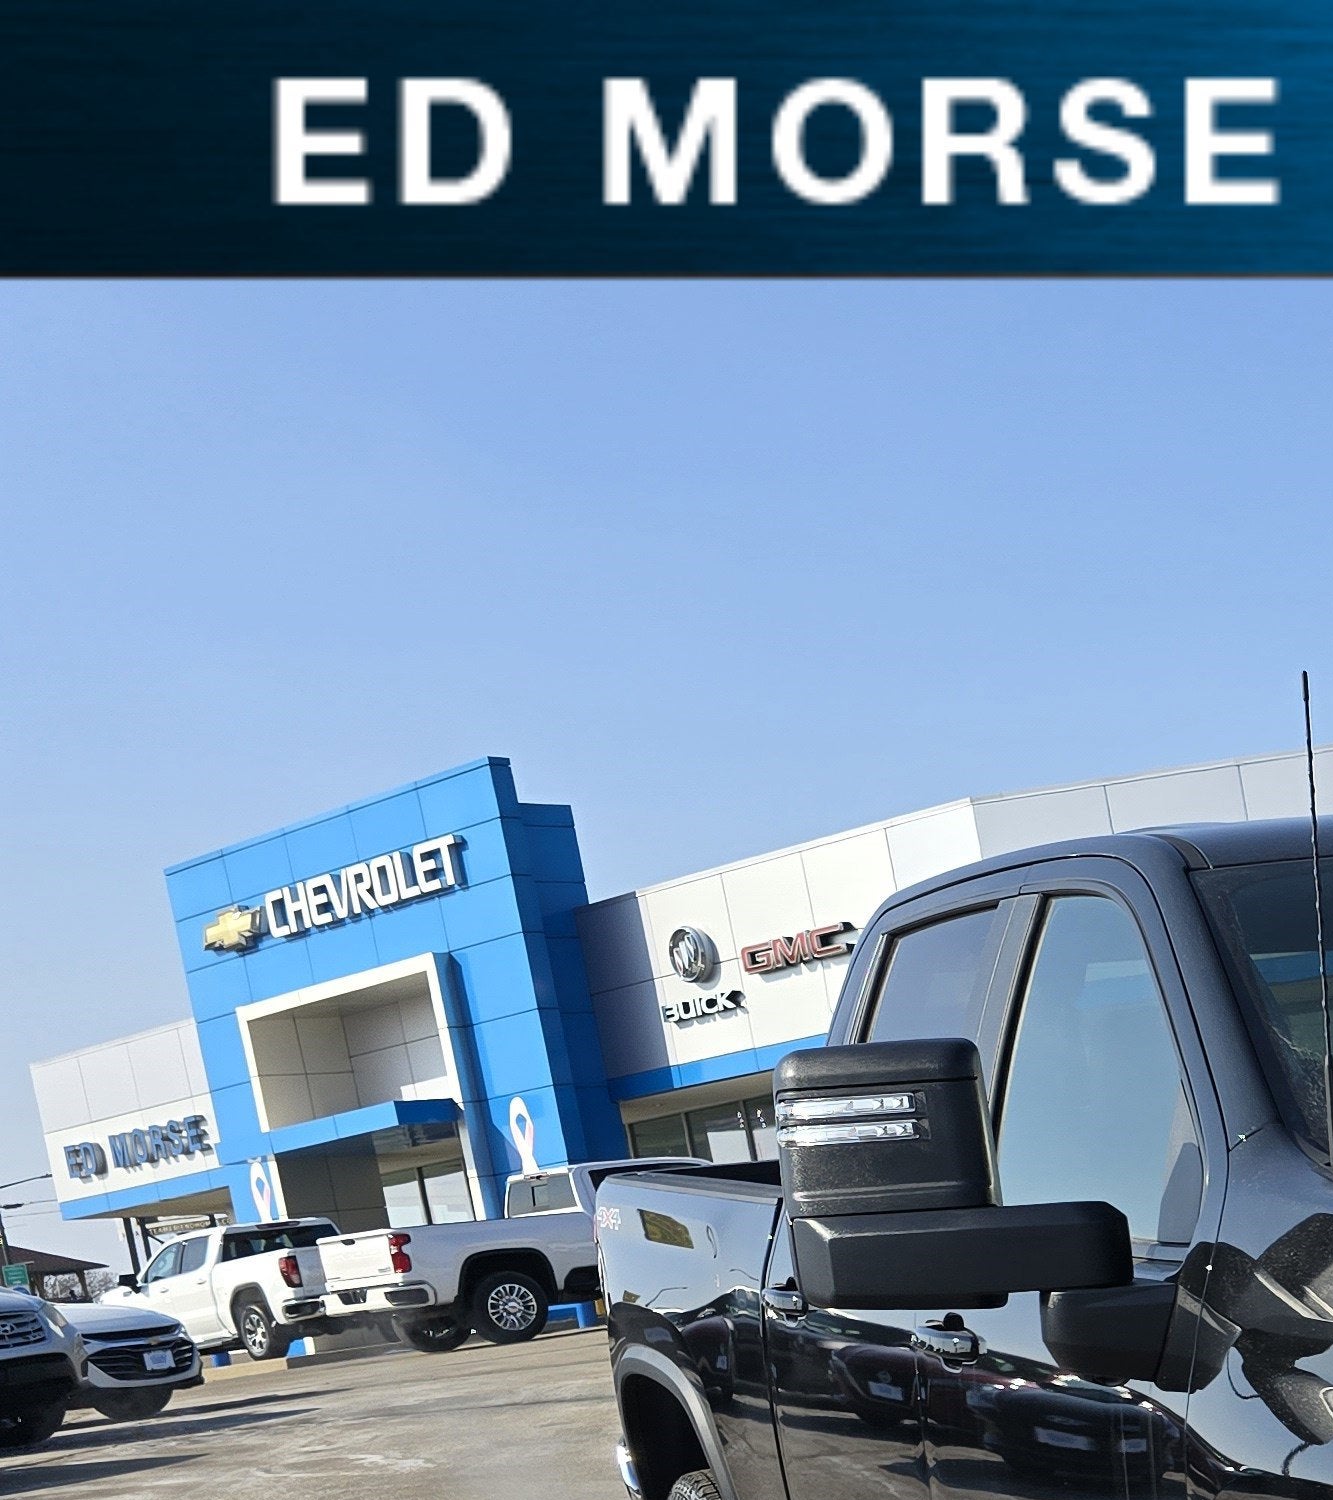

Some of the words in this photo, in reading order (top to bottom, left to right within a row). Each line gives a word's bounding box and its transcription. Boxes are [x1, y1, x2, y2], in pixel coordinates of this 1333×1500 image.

[264, 833, 461, 939] CHEVROLET
[740, 922, 848, 975] GMC
[663, 990, 743, 1024] BUICK
[63, 1141, 103, 1179] ED
[107, 1114, 209, 1168] MORSE
